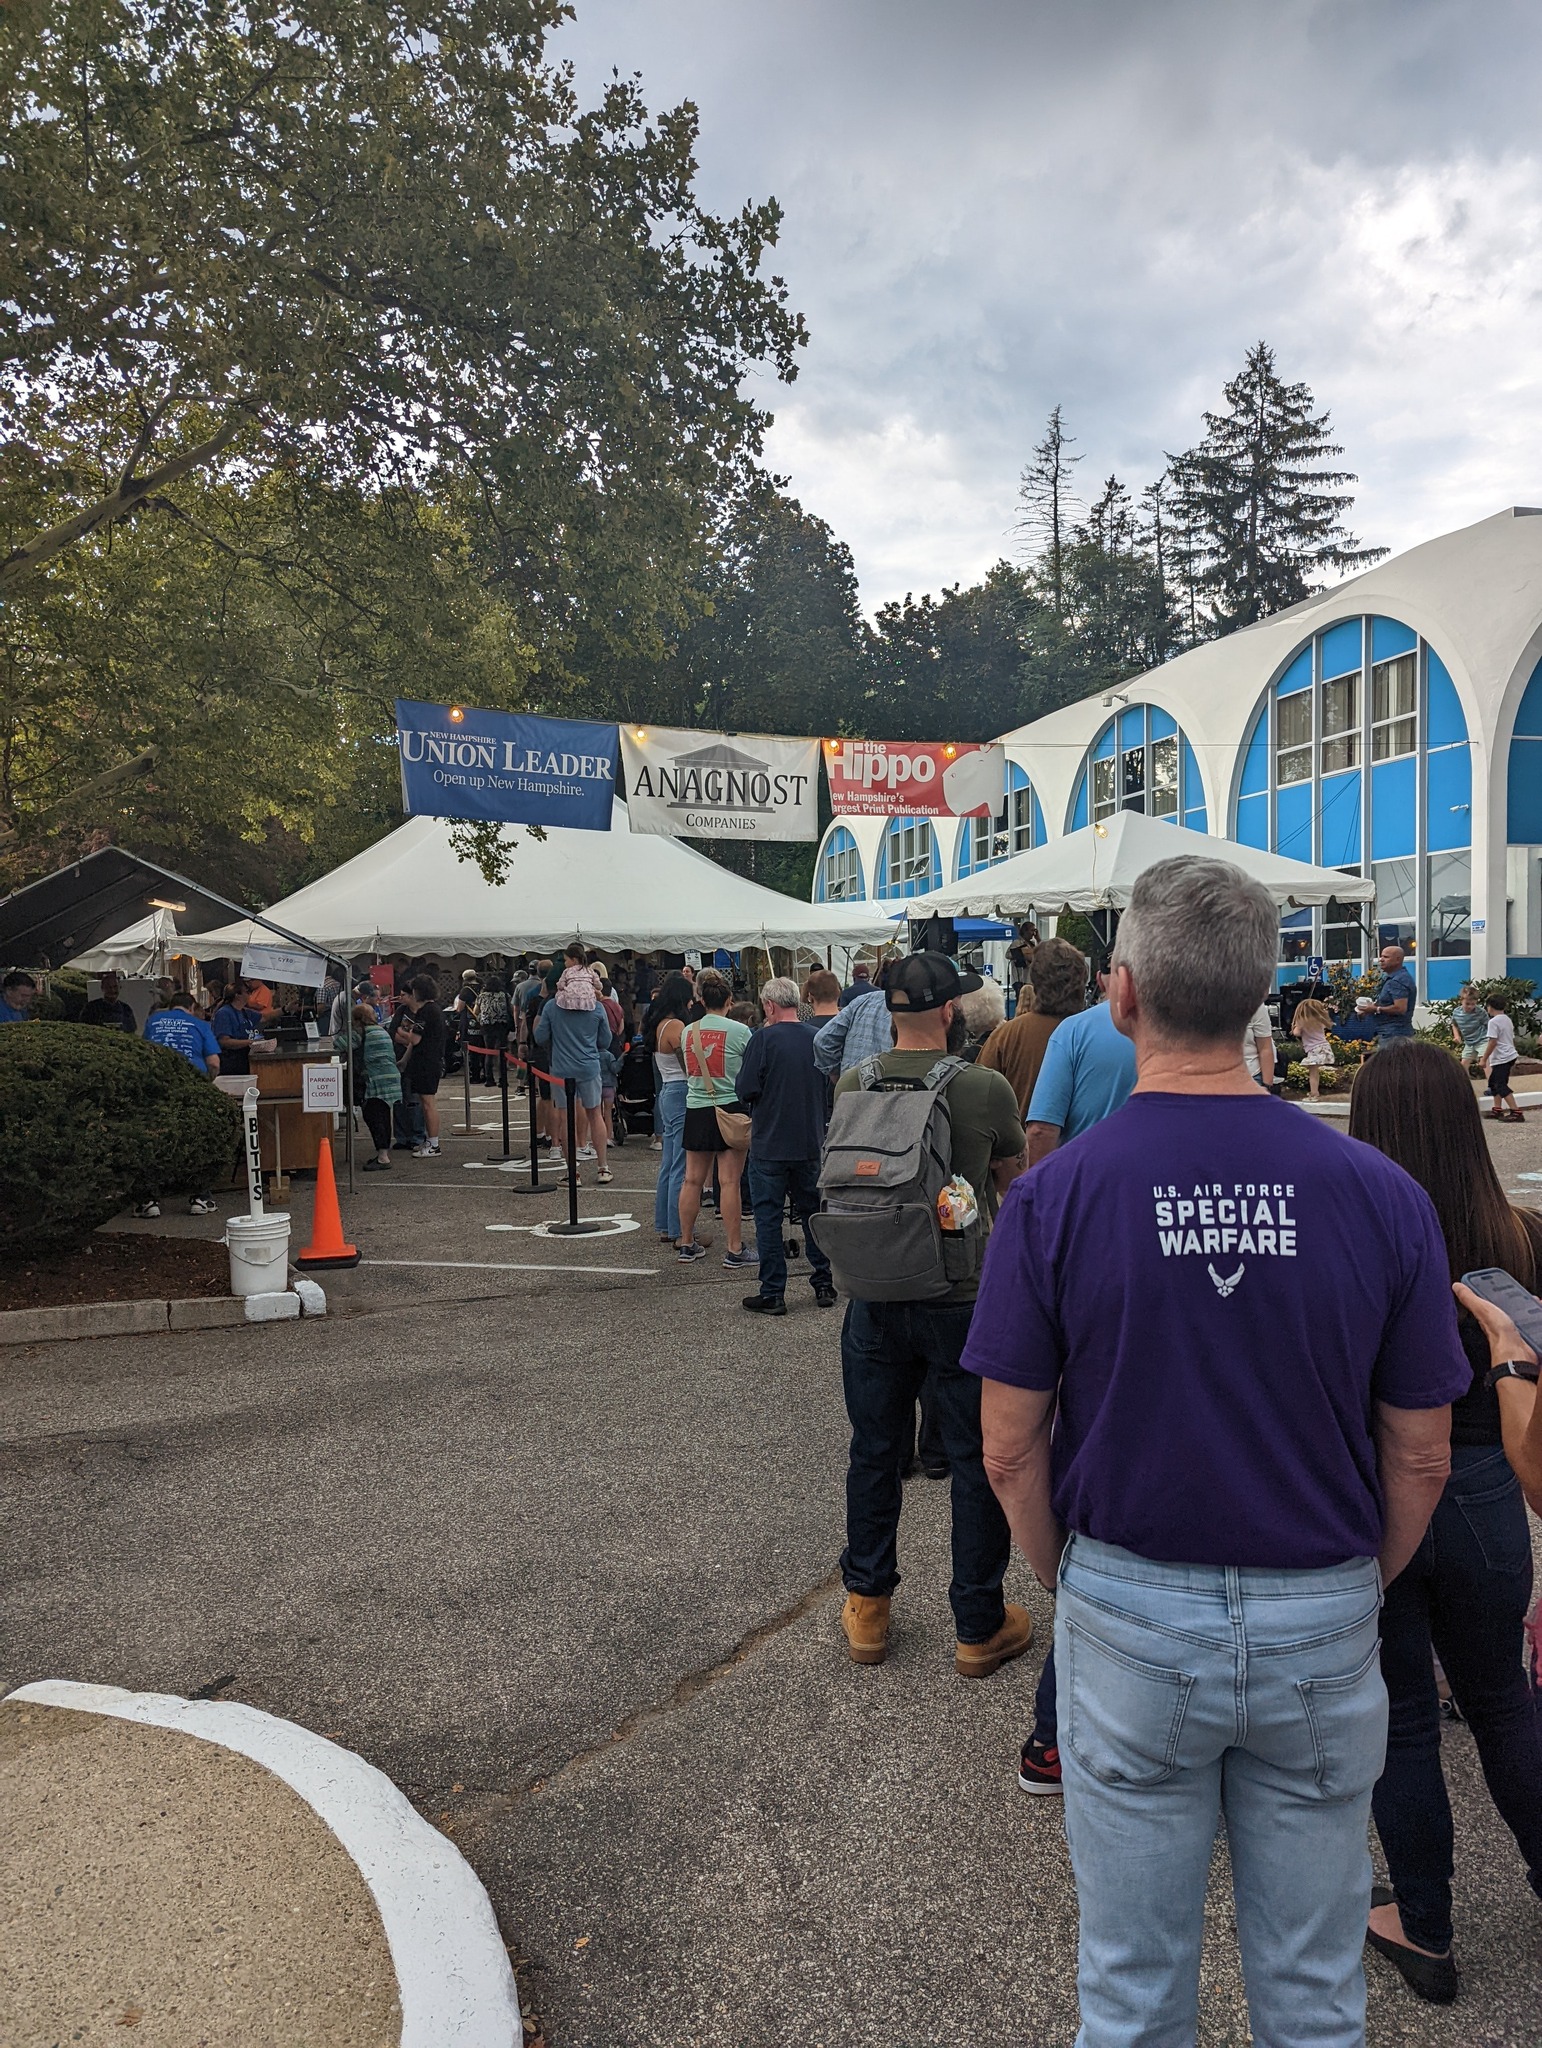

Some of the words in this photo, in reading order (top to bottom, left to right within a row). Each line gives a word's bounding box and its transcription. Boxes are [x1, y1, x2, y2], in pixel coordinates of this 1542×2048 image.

[429, 731, 449, 740] NEW
[449, 733, 497, 745] HAMPSHIRE
[864, 741, 886, 754] the
[400, 730, 498, 769] UNION
[502, 741, 614, 780] LEADER
[824, 742, 936, 789] Hippo
[433, 769, 466, 787] Open
[469, 776, 485, 790] up
[487, 775, 515, 790] New
[518, 778, 585, 797] Hampshire.
[632, 765, 808, 806] ANAGNOST
[832, 792, 845, 801] ew
[847, 791, 904, 803] Hampshire's
[686, 813, 756, 830] COMPANIES
[832, 803, 861, 815] argest
[863, 803, 885, 814] Print
[887, 803, 939, 815] Publication
[248, 1117, 262, 1201] BUTTS
[1153, 1185, 1182, 1198] U.S.
[1193, 1184, 1222, 1197] AIR
[1234, 1184, 1295, 1197] FORCE
[1155, 1199, 1296, 1227] SPECIAL
[1158, 1228, 1297, 1257] WARFARE
